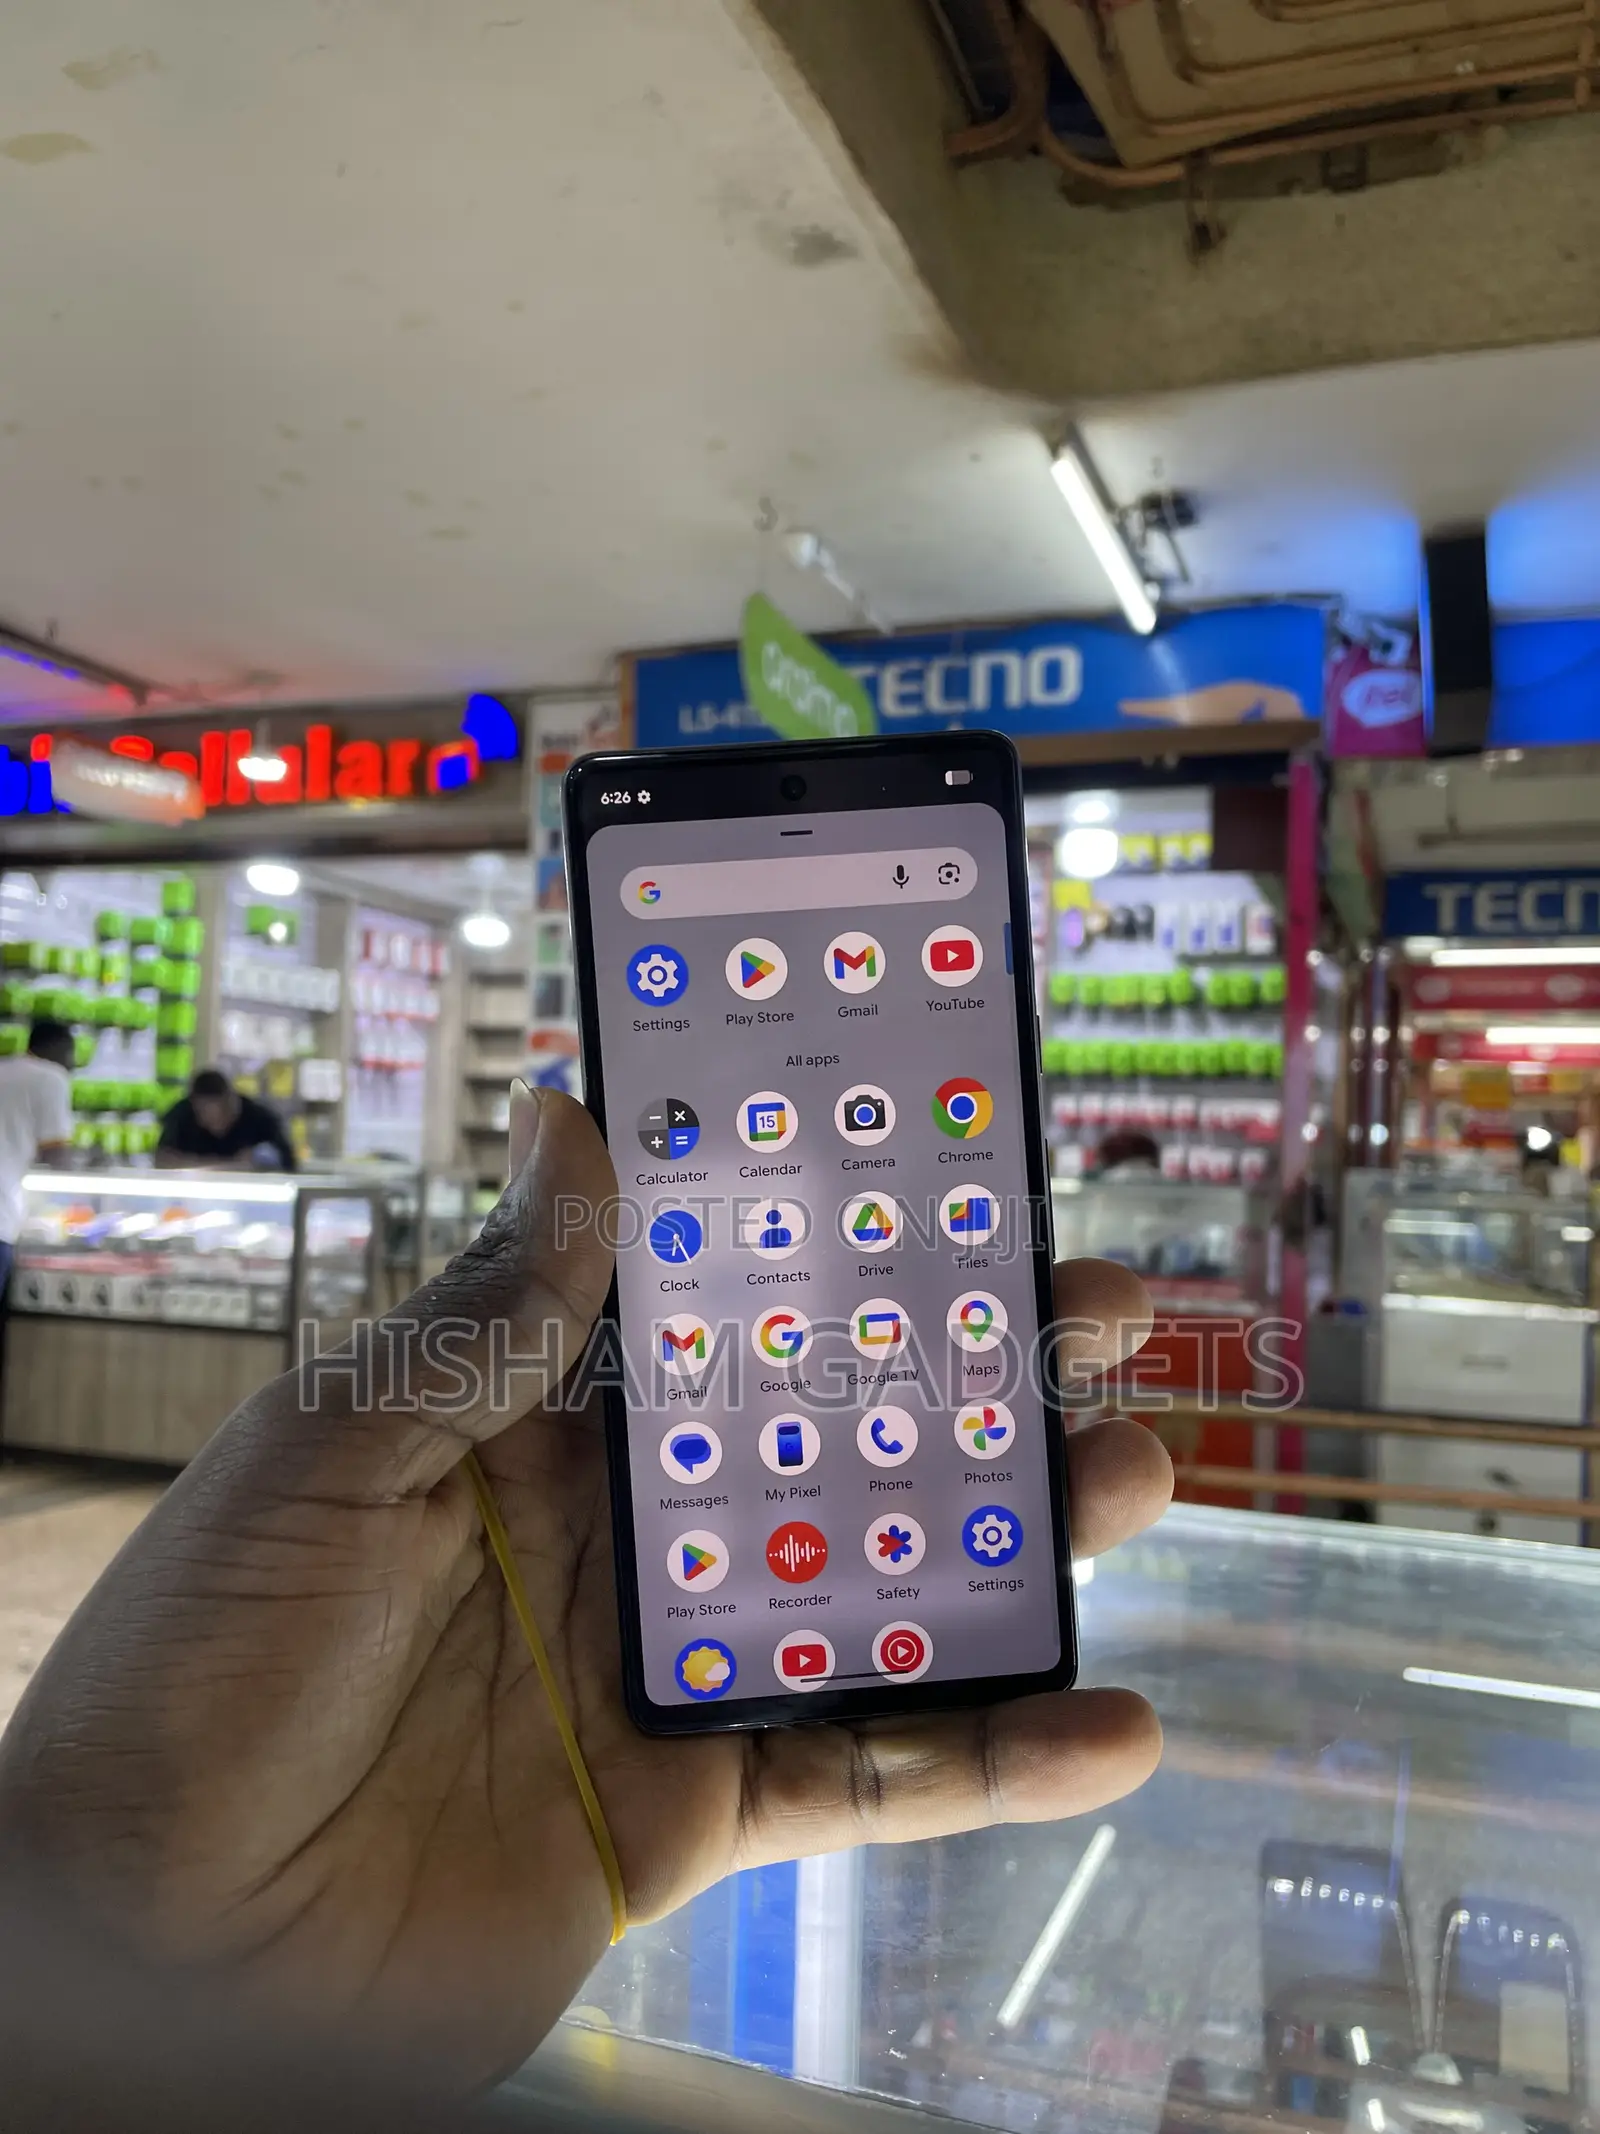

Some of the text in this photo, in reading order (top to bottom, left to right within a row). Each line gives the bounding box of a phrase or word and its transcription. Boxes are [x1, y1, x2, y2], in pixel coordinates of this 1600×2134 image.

[601, 791, 631, 805] 6:26
[838, 1004, 879, 1018] Gmail
[926, 998, 985, 1012] YouTube
[633, 1017, 690, 1032] Settings
[726, 1010, 794, 1028] Play Store
[786, 1054, 840, 1069] All apps
[759, 1114, 776, 1129] 15
[841, 1156, 896, 1171] Camera
[938, 1149, 994, 1164] Chrome
[636, 1169, 708, 1186] Calculator
[739, 1162, 802, 1178] Calendar
[858, 1263, 894, 1277] Drive
[957, 1256, 988, 1270] Files
[660, 1278, 700, 1292] Clock
[746, 1270, 811, 1286] Contacts
[847, 1369, 920, 1387] Google TV
[963, 1363, 1000, 1379] Maps
[667, 1386, 708, 1400] Gmail
[760, 1378, 811, 1394] Google
[869, 1477, 913, 1492] Phone
[964, 1470, 1013, 1484] Photos
[765, 1485, 822, 1503] My Pixel
[660, 1494, 729, 1511] Messages
[968, 1577, 1025, 1594] Settings
[769, 1593, 832, 1610] Recorder
[876, 1586, 921, 1602] Safety
[667, 1602, 737, 1620] Play Store
